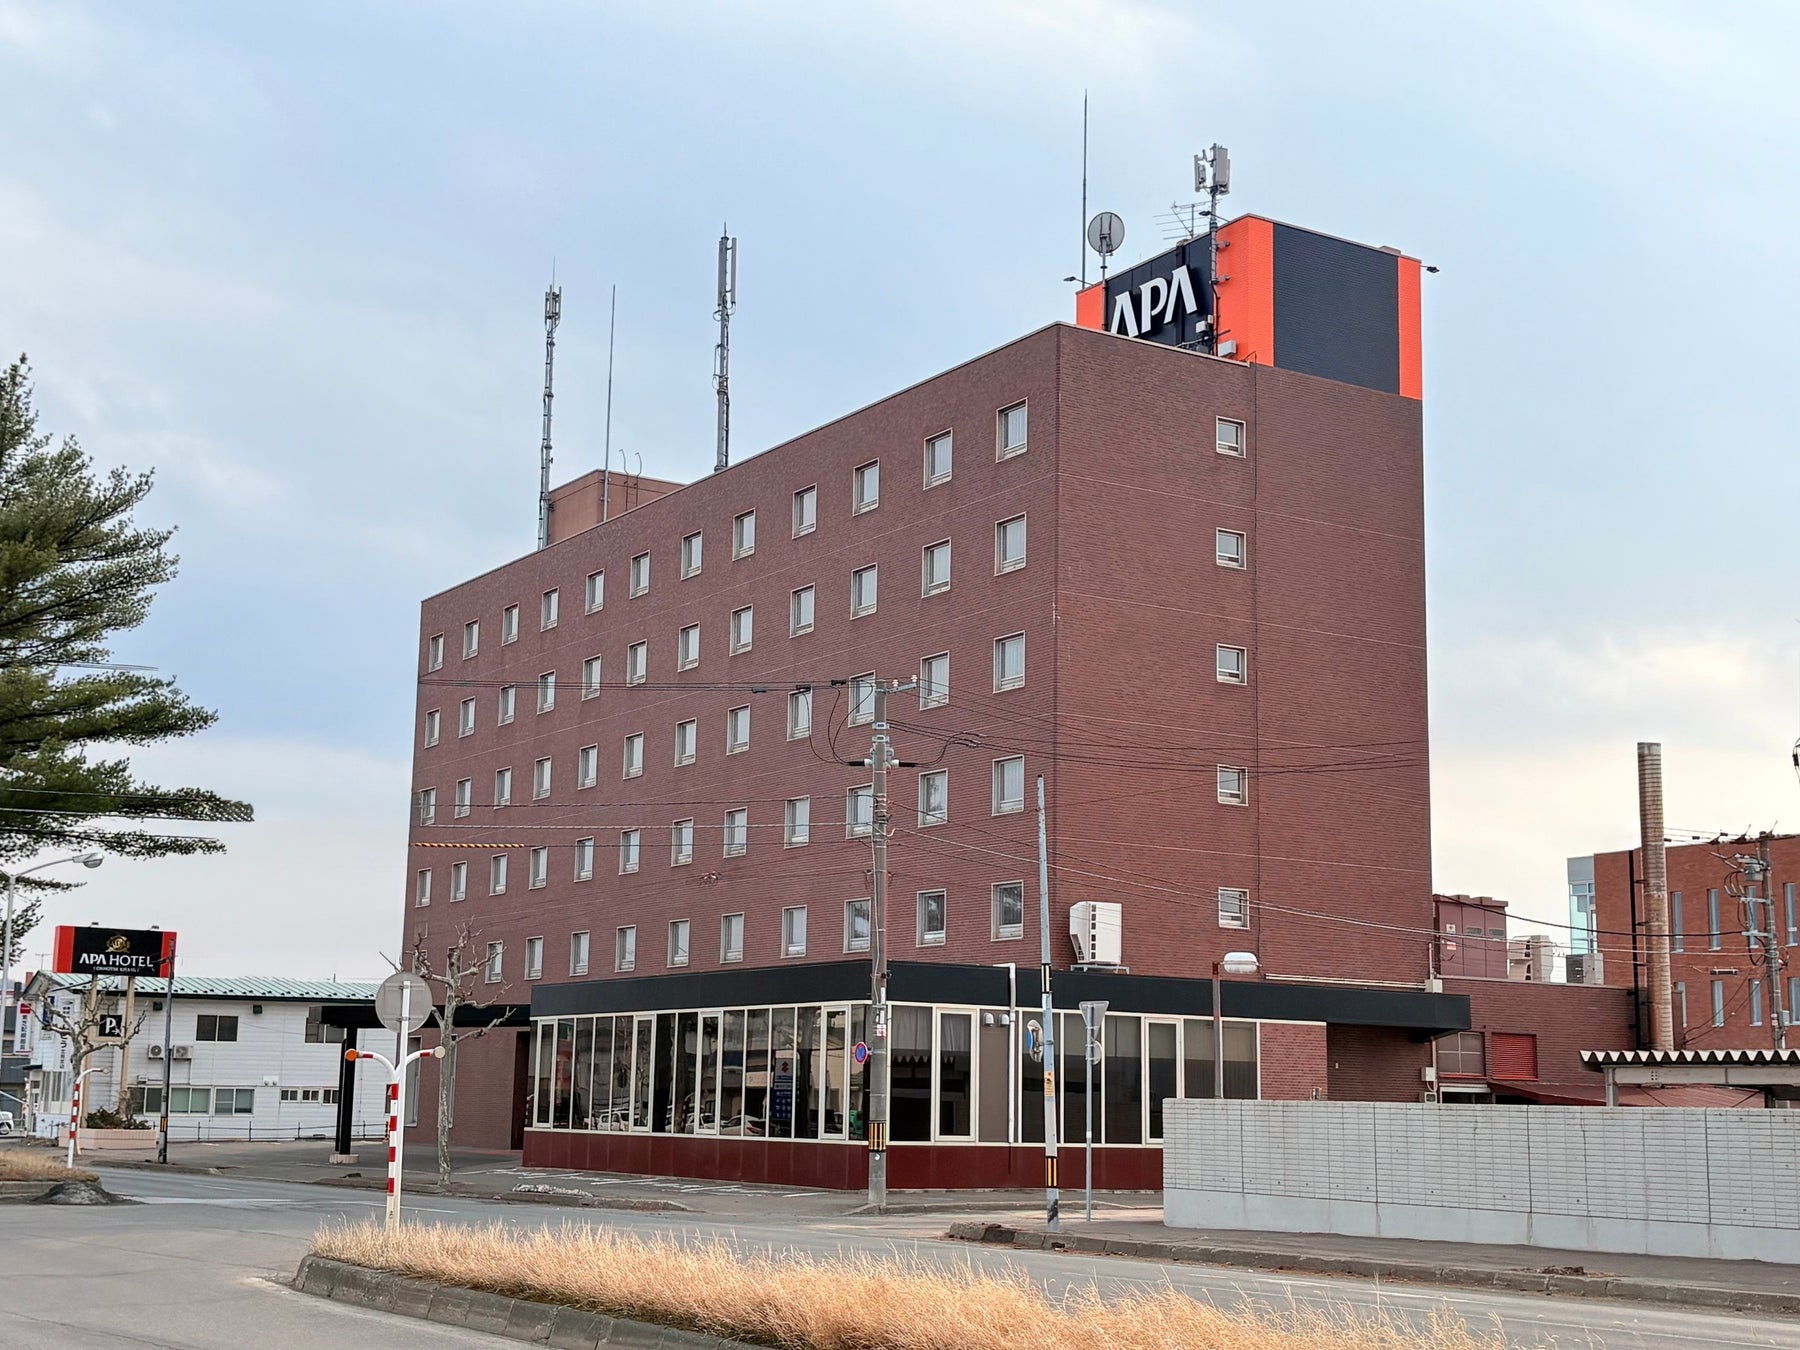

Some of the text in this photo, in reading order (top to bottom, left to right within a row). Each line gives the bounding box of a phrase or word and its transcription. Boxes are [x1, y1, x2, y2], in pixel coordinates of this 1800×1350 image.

[1110, 264, 1198, 338] APA
[79, 953, 154, 967] APA HOTEL
[105, 1017, 117, 1034] P
